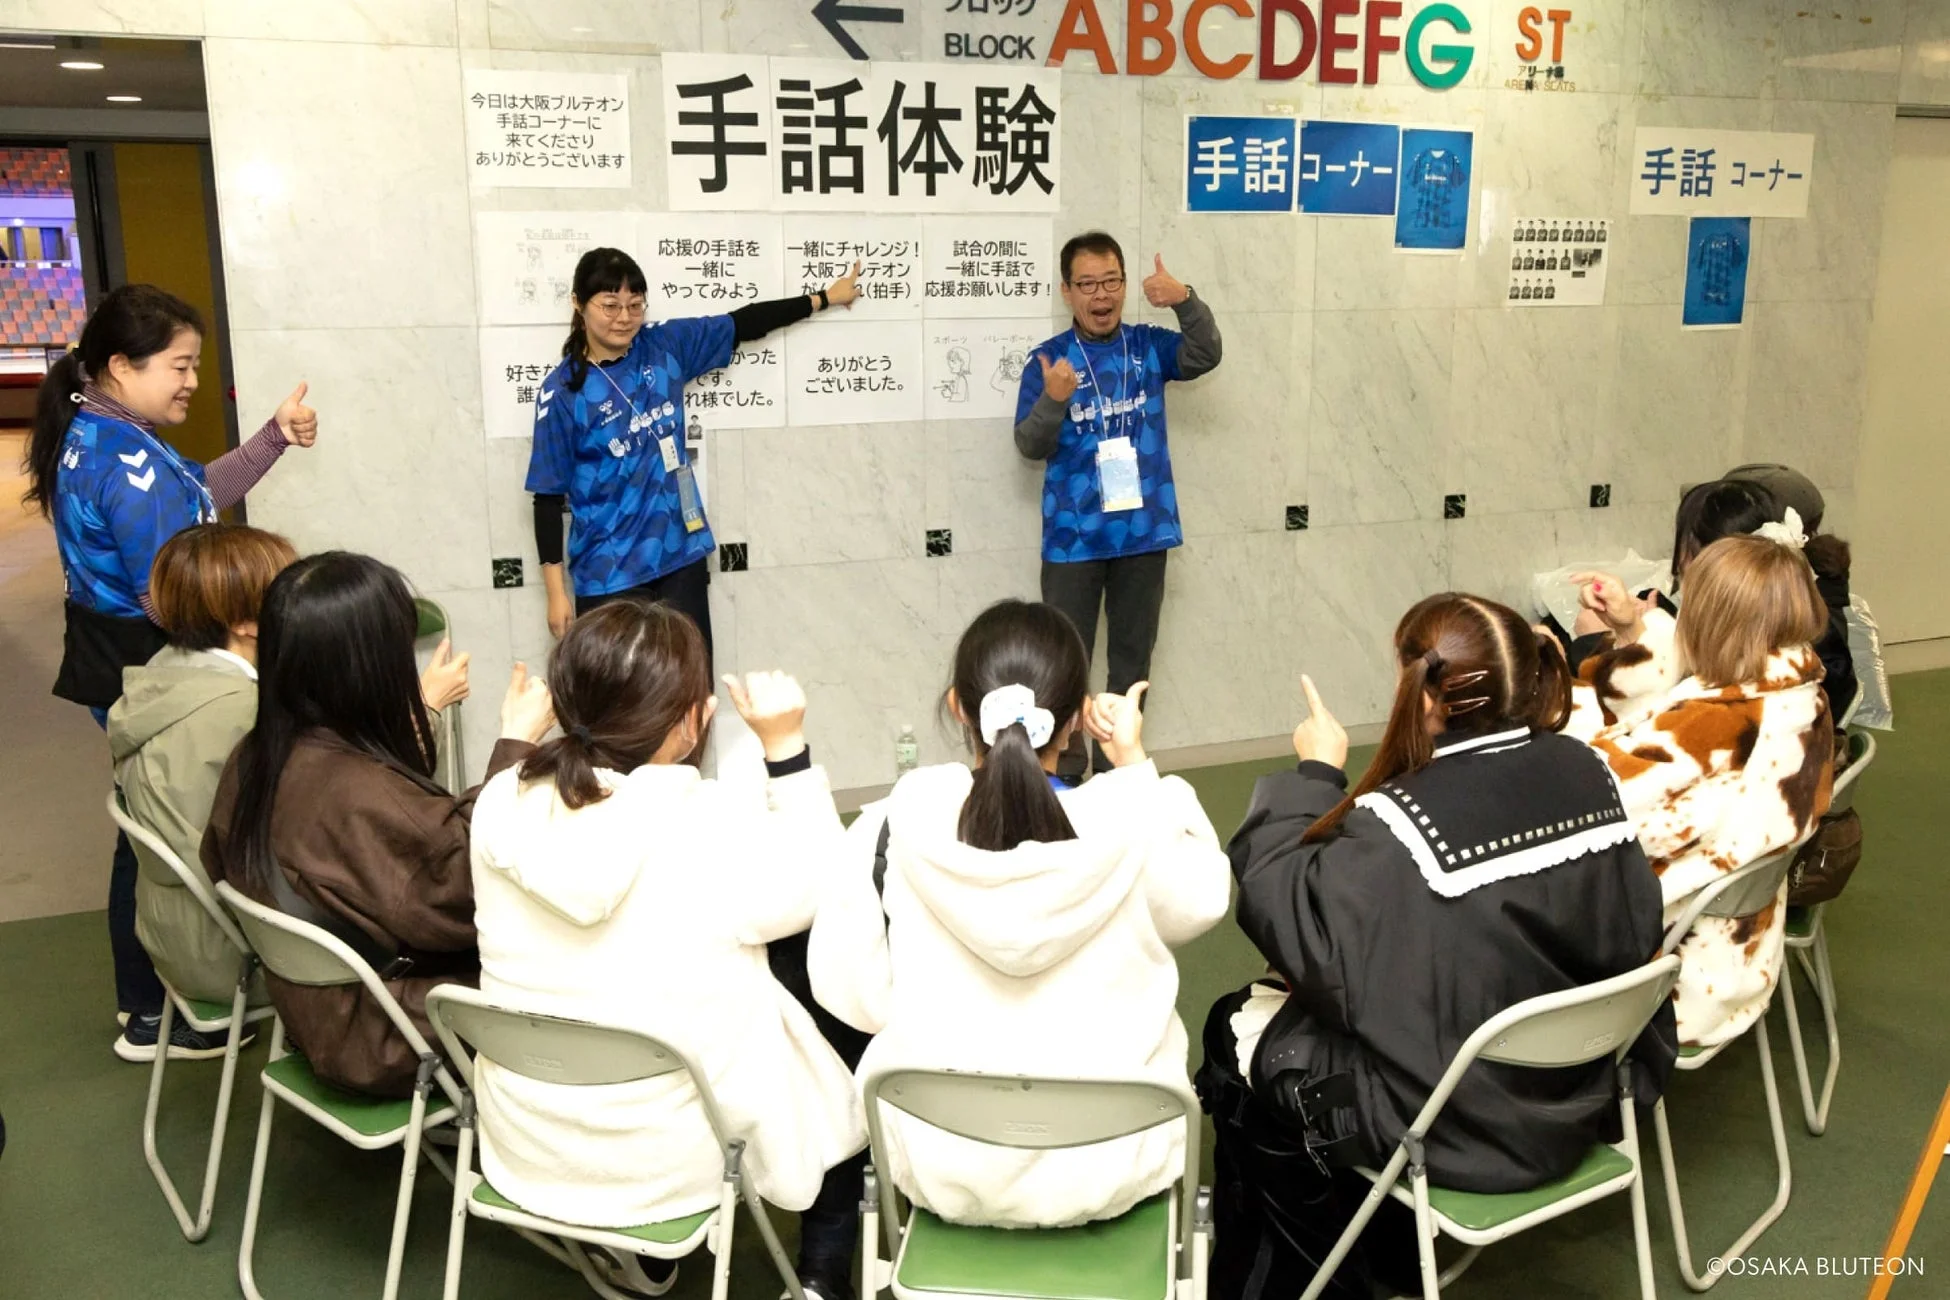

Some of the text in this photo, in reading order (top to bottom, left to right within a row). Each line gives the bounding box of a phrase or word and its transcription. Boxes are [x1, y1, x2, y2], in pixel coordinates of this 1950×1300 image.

[1515, 6, 1572, 64] ST
[944, 33, 1035, 60] BLOCK
[470, 92, 625, 112] 今日は大阪ブルテオン
[496, 113, 602, 130] 手話コーナーに
[506, 132, 594, 149] 来てくださり
[671, 73, 1057, 197] 手話体験
[475, 151, 625, 169] ありがとうございます
[1193, 136, 1393, 193] 手話 コーナー
[1641, 147, 1803, 197] 手話 コーナー
[658, 238, 760, 257] 応援の手話を
[953, 240, 1028, 257] 試合の間に
[685, 260, 736, 278] 一緒に
[945, 260, 1035, 277] 一緒に手話で
[661, 282, 758, 299] やってみよう
[924, 280, 1051, 298] 応援お願いします！
[817, 355, 892, 373] ありがとう
[805, 374, 904, 393] ございました。
